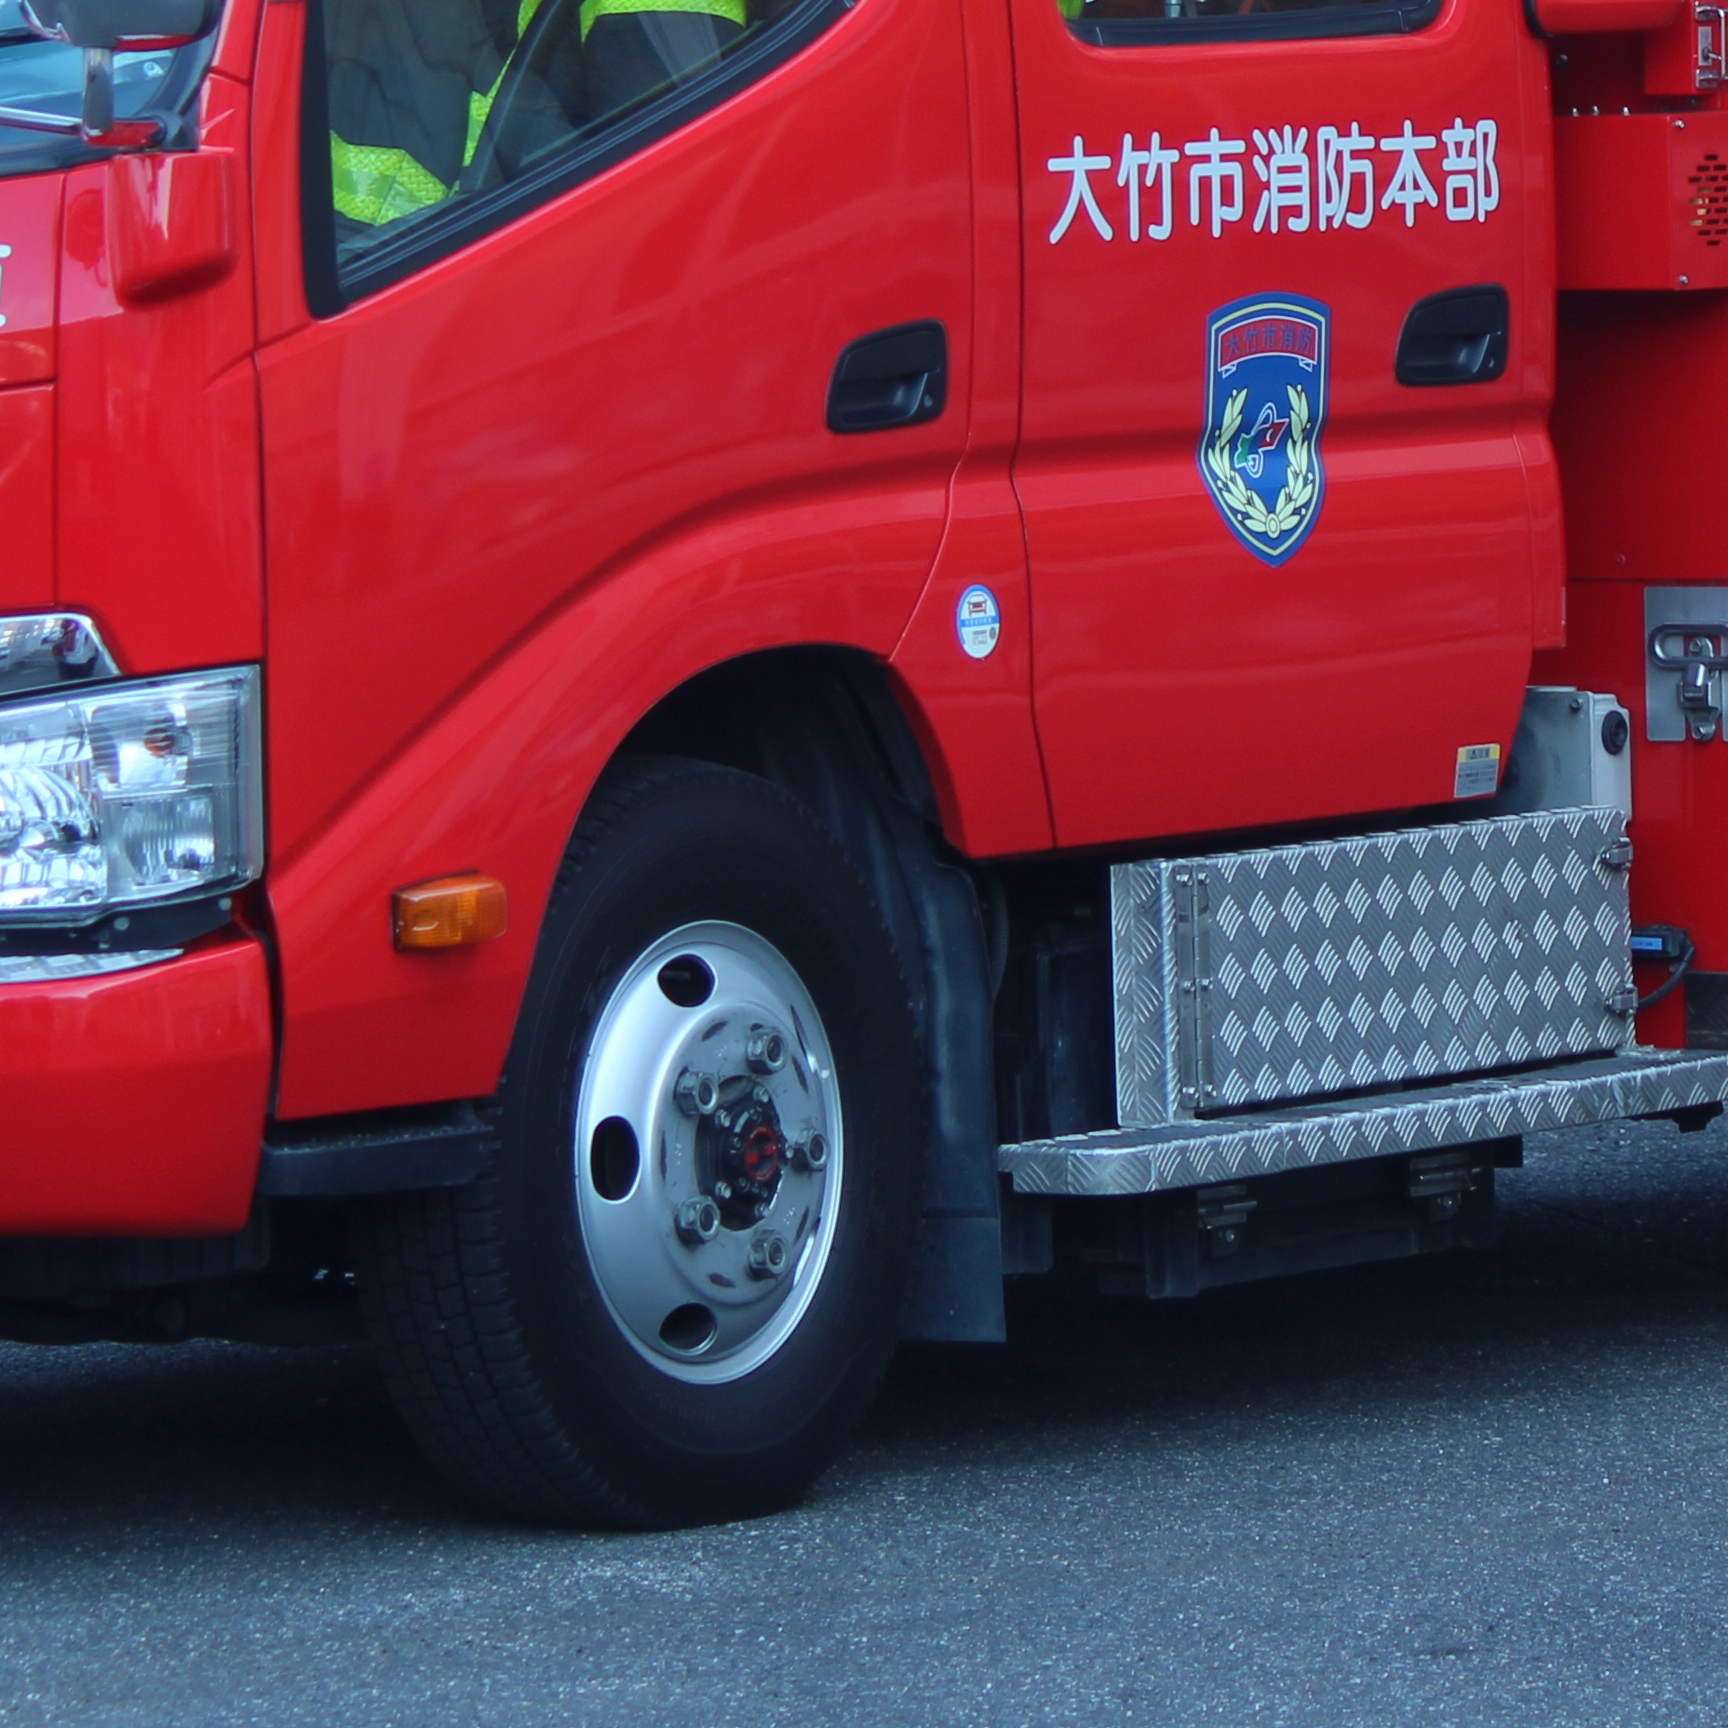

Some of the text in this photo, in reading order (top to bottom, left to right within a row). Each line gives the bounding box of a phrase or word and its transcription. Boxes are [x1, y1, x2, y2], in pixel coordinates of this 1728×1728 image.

[1047, 118, 1500, 244] 大竹市消防本部
[1225, 324, 1312, 360] 大竹市消防
